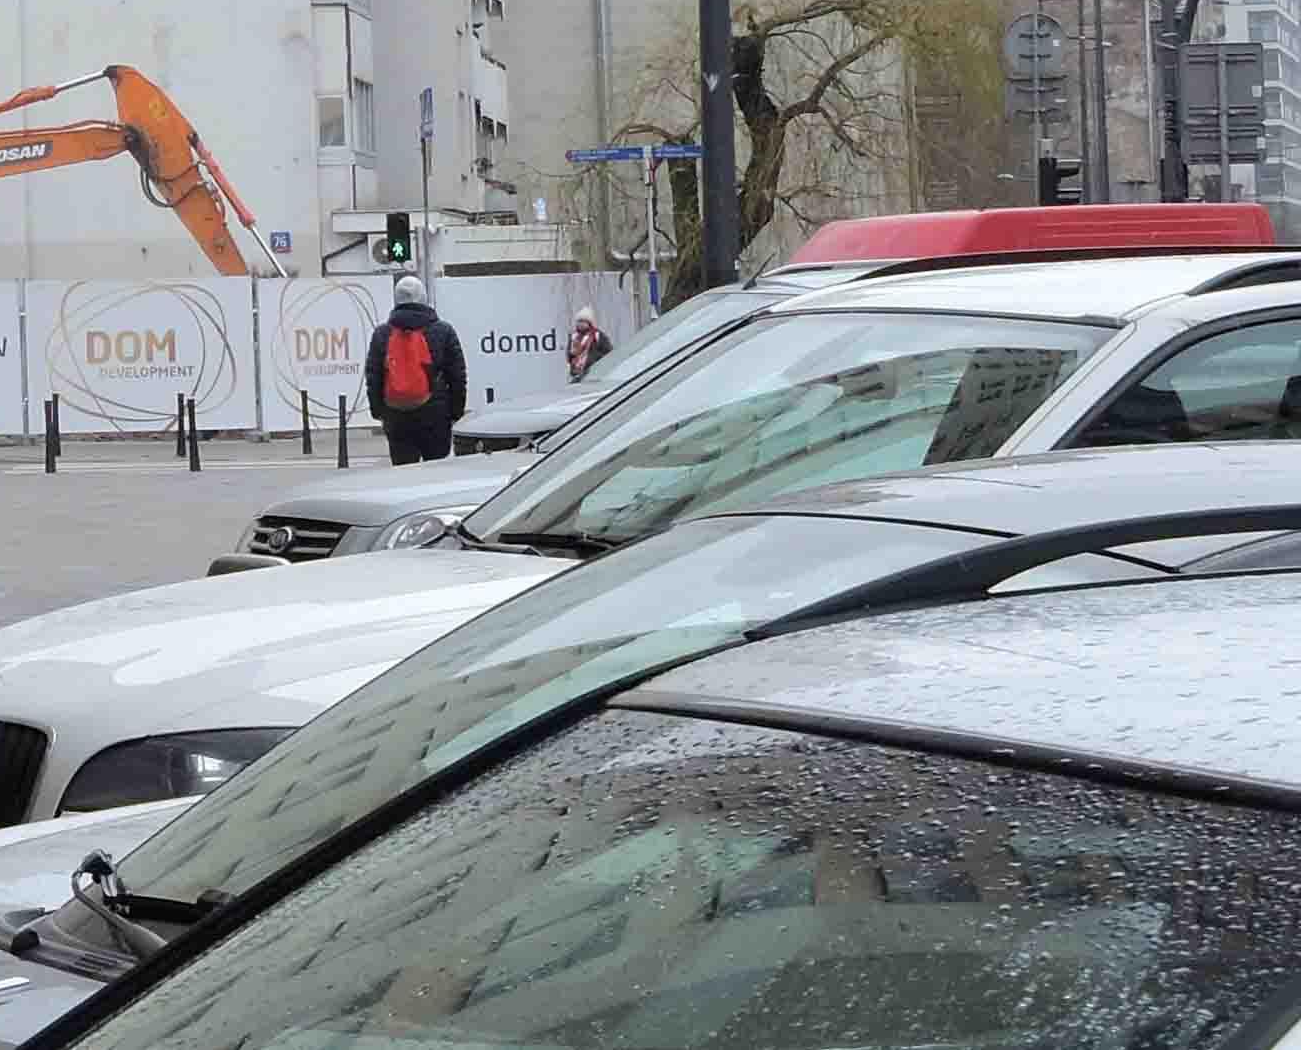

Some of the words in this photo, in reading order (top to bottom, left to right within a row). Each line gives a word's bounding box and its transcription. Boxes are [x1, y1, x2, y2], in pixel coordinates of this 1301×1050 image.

[85, 327, 177, 364] DOM
[294, 326, 351, 361] DOM
[99, 365, 196, 380] DEVELOPMENT
